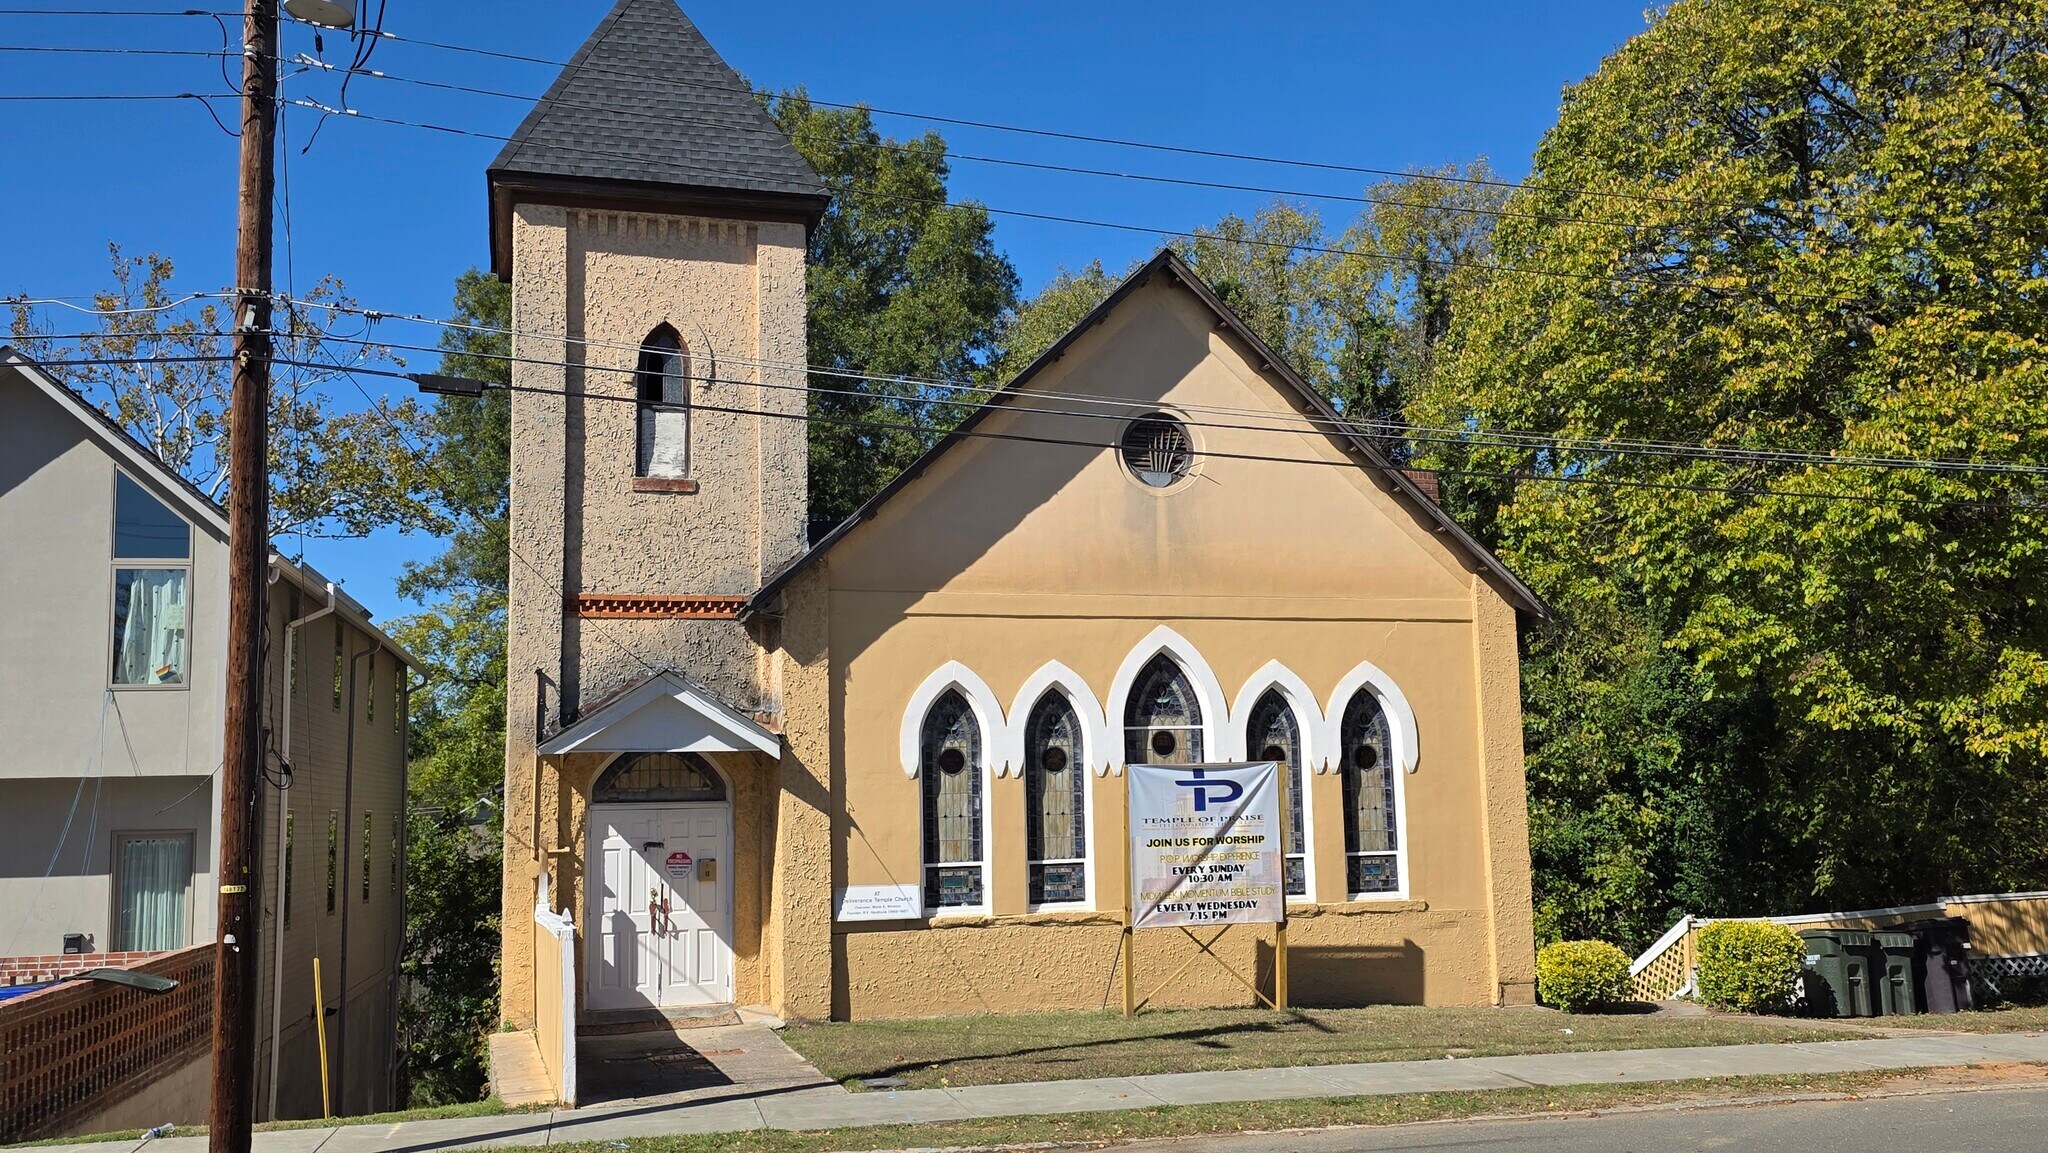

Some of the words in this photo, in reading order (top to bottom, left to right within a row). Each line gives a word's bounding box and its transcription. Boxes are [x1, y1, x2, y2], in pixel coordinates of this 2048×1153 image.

[1220, 814, 1264, 822] PRAISE
[1146, 839, 1172, 848] JOIN
[1175, 838, 1190, 846] US
[1192, 837, 1214, 846] FOR
[1216, 835, 1265, 845] WORSHIP
[1172, 866, 1206, 875] EVERY
[1209, 864, 1245, 873] SUNDAY
[1188, 874, 1214, 883] 10:30
[1217, 873, 1233, 882] AM
[1179, 888, 1230, 899] MOMENTUM
[1230, 887, 1251, 897] BIBLE
[1251, 886, 1277, 896] STUDY
[1156, 903, 1193, 912] EVERY
[1196, 900, 1258, 911] WEDNESDAY
[1189, 911, 1209, 920] 7:15
[1212, 911, 1228, 919] PM
